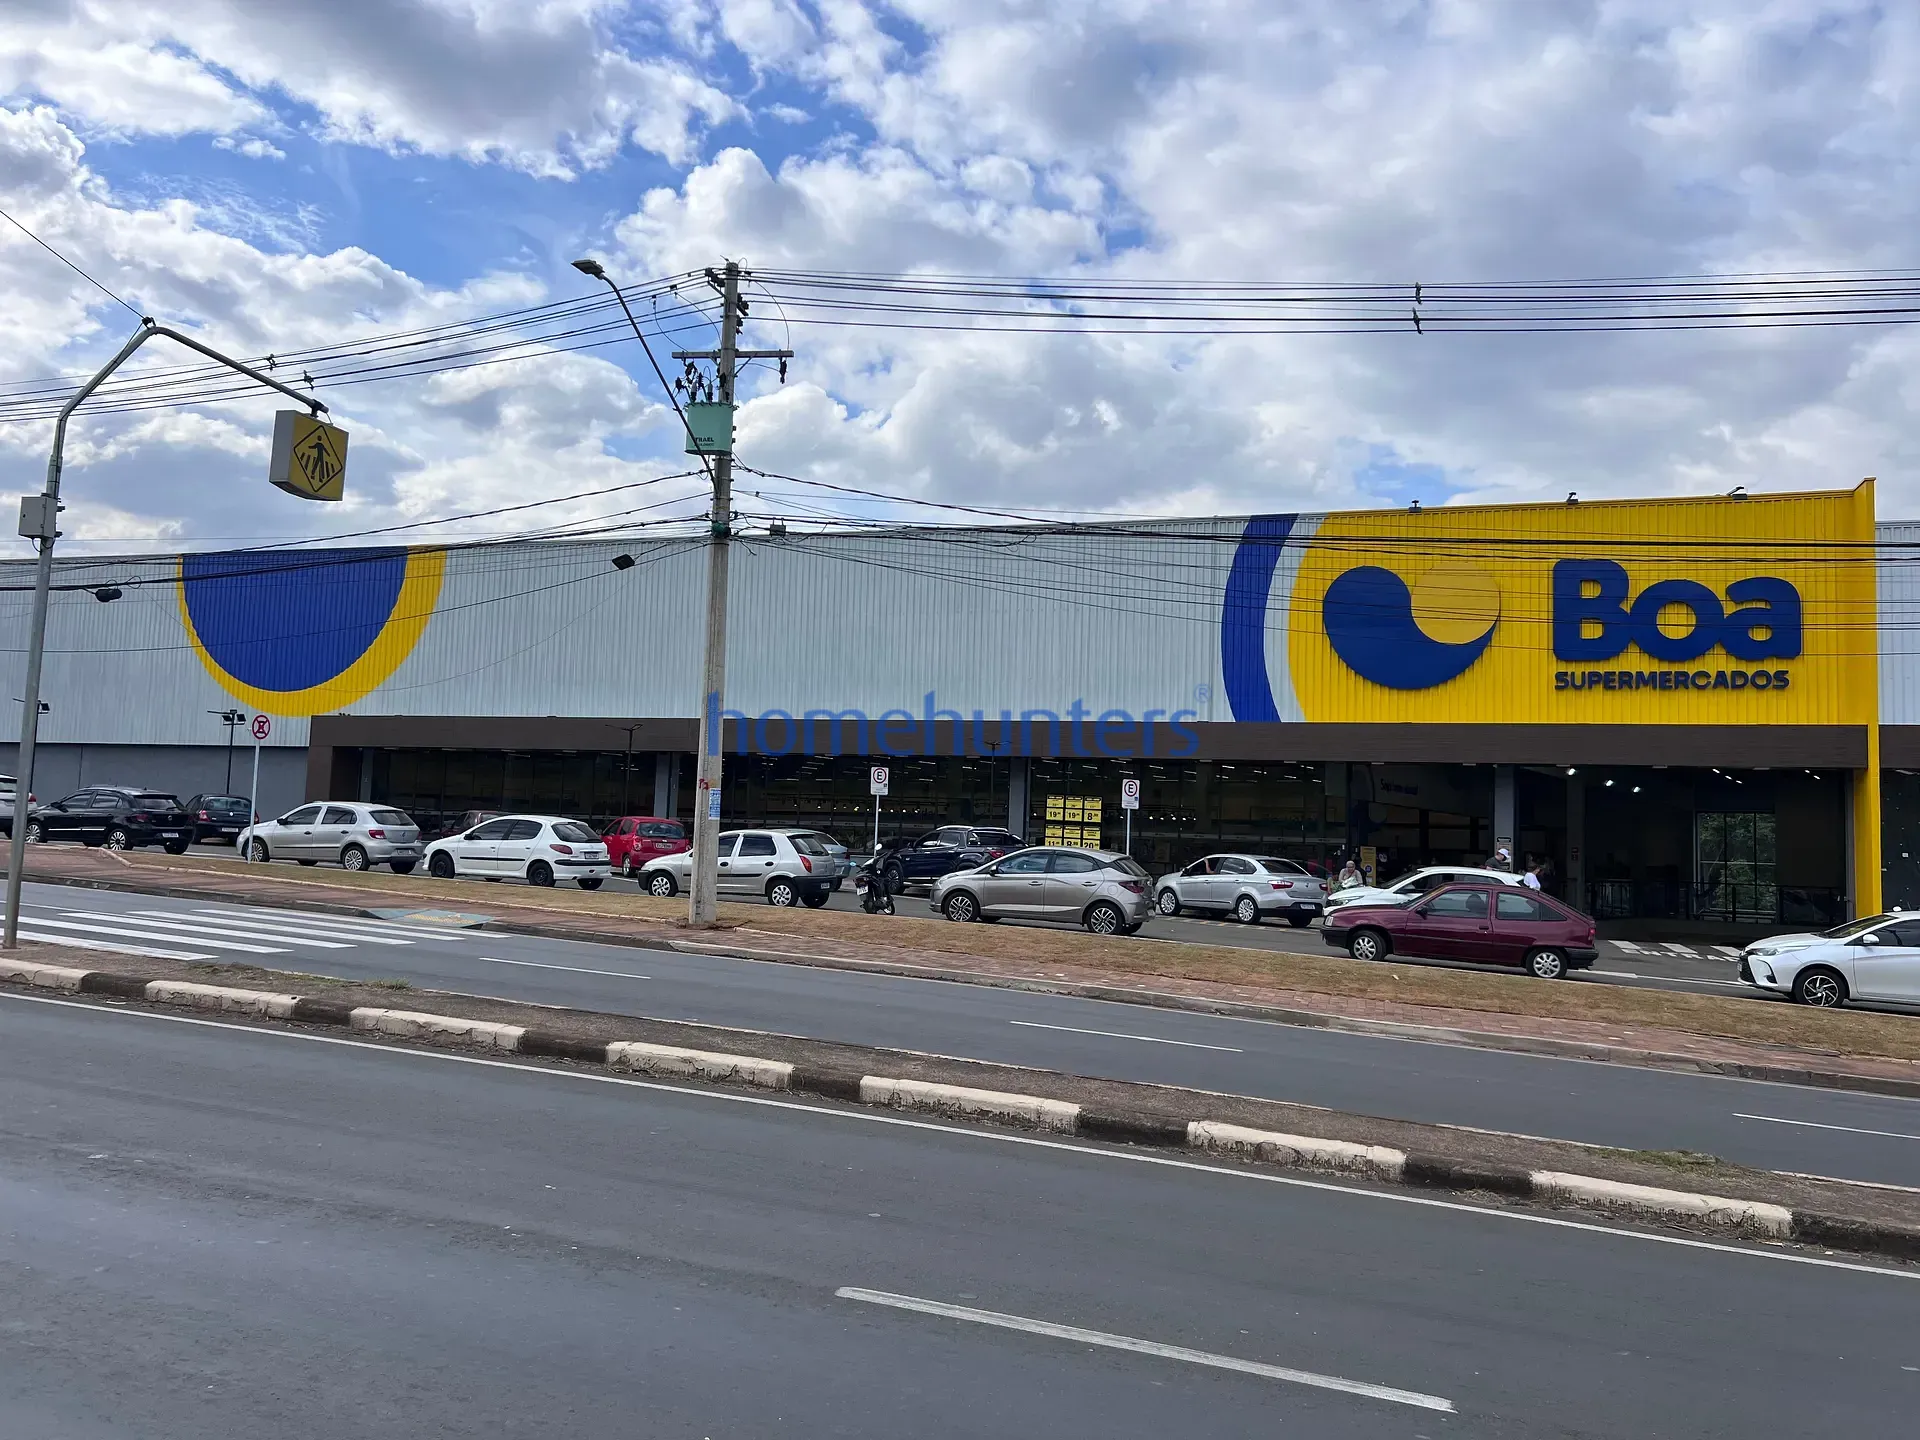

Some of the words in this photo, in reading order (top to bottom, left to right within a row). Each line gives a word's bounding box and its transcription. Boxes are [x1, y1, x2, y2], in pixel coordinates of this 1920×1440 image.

[1553, 558, 1802, 661] Boa
[1554, 669, 1790, 690] SUPERMERCADOS
[877, 771, 883, 780] E
[1128, 784, 1133, 793] E
